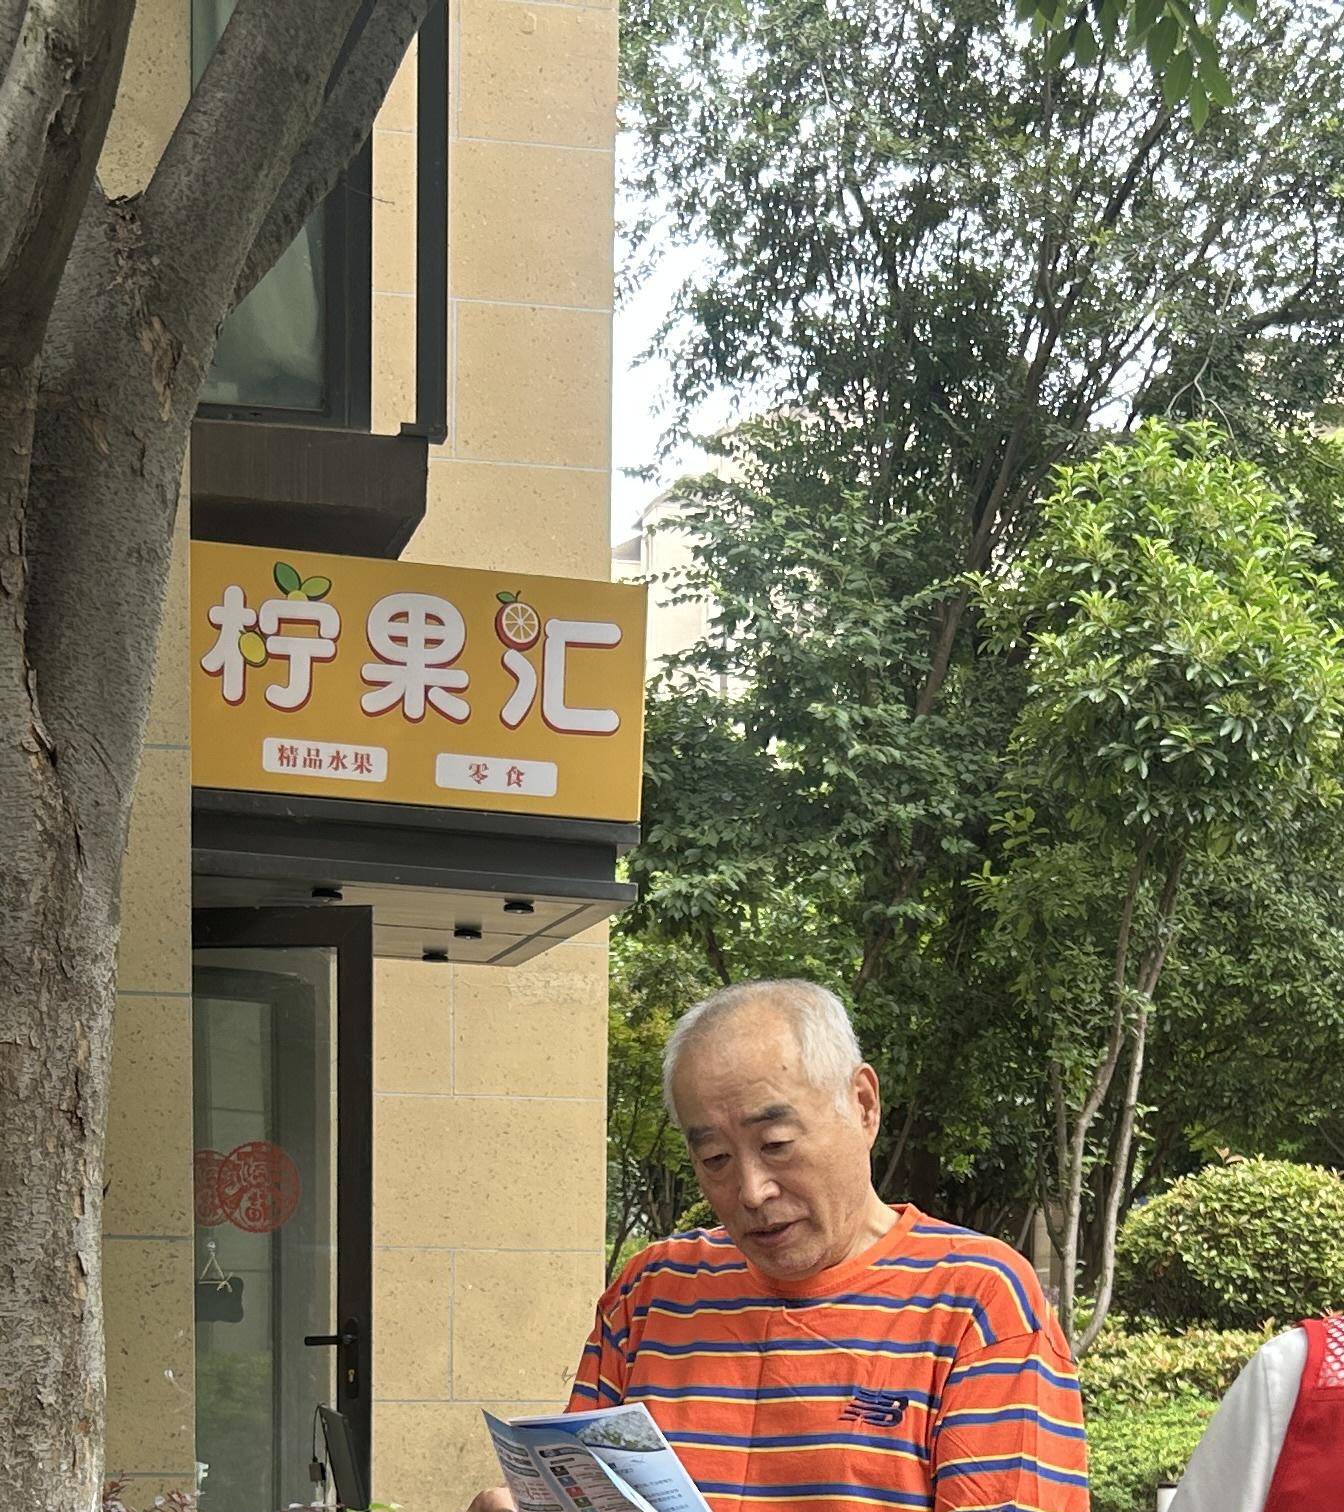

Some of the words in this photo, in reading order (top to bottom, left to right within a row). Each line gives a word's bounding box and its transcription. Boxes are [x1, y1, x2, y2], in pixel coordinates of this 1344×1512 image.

[201, 583, 623, 733] 柠果汇
[276, 743, 374, 775] 精品水果
[467, 761, 526, 788] 零食
